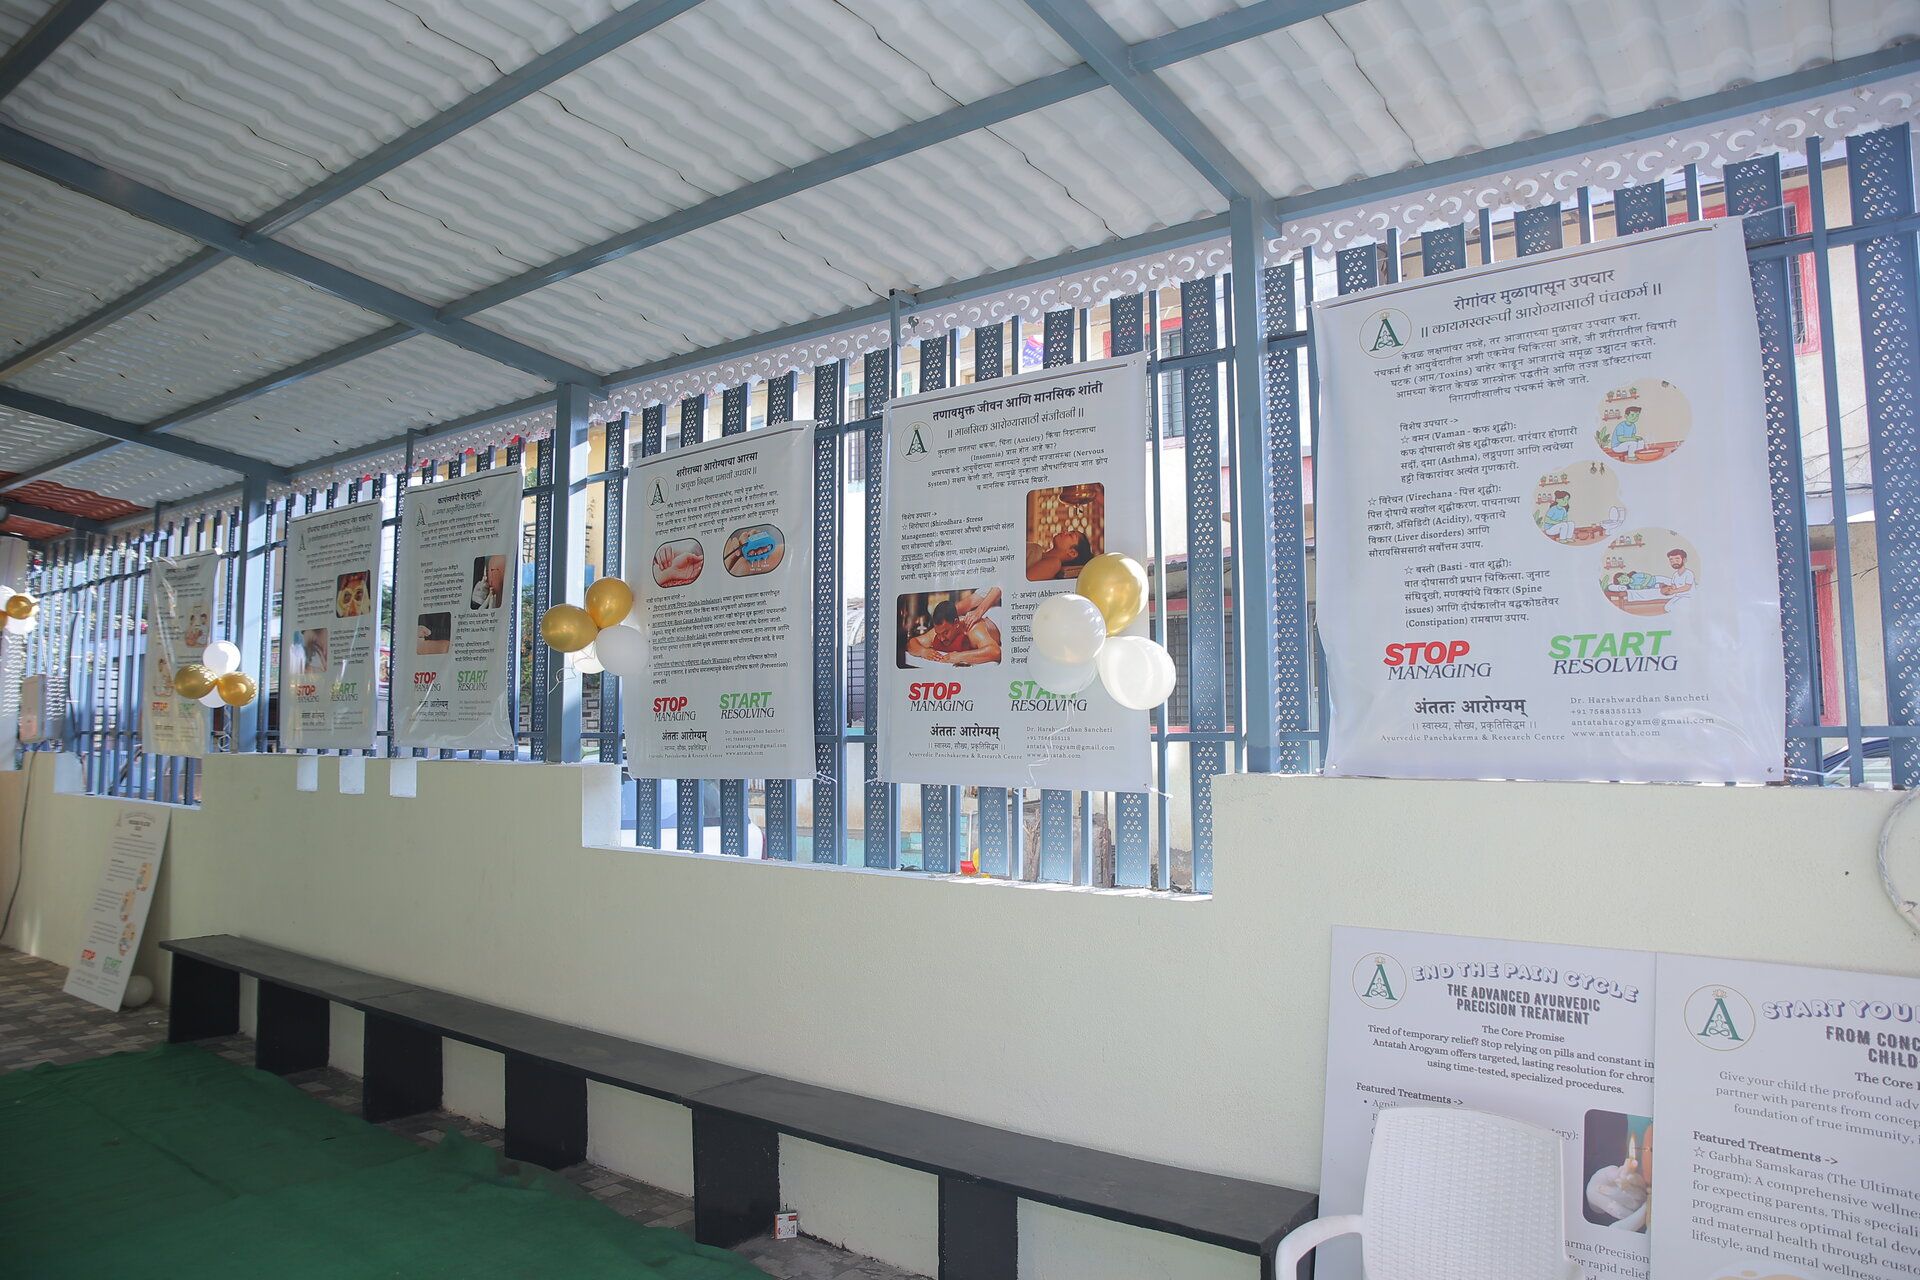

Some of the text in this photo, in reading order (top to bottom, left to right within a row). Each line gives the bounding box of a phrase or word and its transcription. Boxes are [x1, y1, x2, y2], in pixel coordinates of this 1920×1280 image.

[1453, 268, 1615, 311] रोगांवर मुळापासून उपचार
[1598, 280, 1649, 303] पंचकर्म
[932, 379, 1103, 421] तणावमुक्त जीवन आणि मानसिक शांती
[1432, 429, 1465, 441] (Vaman
[1517, 443, 1539, 455] आणि
[1405, 615, 1467, 629] (Constipation)
[1383, 640, 1470, 666] STOP
[1547, 630, 1672, 660] START
[1387, 662, 1493, 680] MANAGING
[1553, 655, 1679, 676] RESOLVING
[414, 671, 437, 684] STOP
[457, 670, 488, 683] START
[719, 691, 772, 710] START
[908, 682, 961, 701] STOP
[1570, 692, 1710, 704] Dr. Harshwardhan Sancheti
[653, 696, 688, 713] STOP
[720, 707, 775, 720] RESOLVING
[910, 700, 974, 712] MANAGING
[1010, 699, 1087, 712] RESOLVING
[1461, 694, 1528, 718] आरोग्यम्
[654, 711, 696, 722] MANAGING
[959, 722, 1001, 741] आरोग्यम्
[1491, 732, 1530, 743] Research
[1534, 732, 1565, 743] Centre
[1410, 961, 1639, 1003] END THE PAIN CYCLE
[1446, 983, 1601, 1012] THE ADVANCED AYURVEDIC
[1456, 998, 1590, 1025] PRECISION TREATMENT
[1762, 1000, 1845, 1020] START
[1481, 1024, 1564, 1043] The Core Promise
[1825, 1025, 1870, 1046] FROM
[1367, 1023, 1390, 1035] Tired
[1392, 1026, 1402, 1036] of
[1402, 1029, 1449, 1044] temporary
[1451, 1034, 1478, 1046] relief?
[1480, 1037, 1502, 1051] Stop
[1504, 1040, 1537, 1056] relying
[1539, 1047, 1552, 1056] on
[1554, 1047, 1574, 1059] pills
[1576, 1050, 1595, 1061] and
[1597, 1054, 1641, 1067] constant
[1372, 1037, 1406, 1050] Antatah
[1408, 1042, 1448, 1056] Arogyam
[1450, 1047, 1476, 1060] offers
[1478, 1052, 1519, 1066] targeted,
[1521, 1055, 1553, 1072] lasting
[1556, 1063, 1606, 1077] resolution
[1609, 1067, 1624, 1079] for
[1426, 1059, 1624, 1094] using time-tested, specialized procedures.
[1854, 1071, 1913, 1090] The Core
[1355, 1080, 1395, 1096] Featured
[1397, 1087, 1451, 1105] Treatments
[1718, 1069, 1744, 1083] Give
[1746, 1075, 1773, 1087] your
[1776, 1078, 1806, 1092] child
[1808, 1083, 1829, 1096] the
[1832, 1089, 1891, 1106] profound
[1715, 1086, 1757, 1103] partner
[1761, 1093, 1787, 1105] with
[1790, 1098, 1836, 1113] parents
[1840, 1103, 1871, 1119] from
[1733, 1102, 1913, 1145] foundation of true immunity,
[1692, 1129, 1744, 1149] Featured
[1748, 1139, 1820, 1163] Treatments
[1708, 1149, 1751, 1167] Garbha
[1755, 1158, 1822, 1181] Samskaras
[1826, 1171, 1855, 1187] (The
[1692, 1162, 1750, 1185] Program):
[1754, 1175, 1763, 1186] A
[1766, 1179, 1867, 1208] comprehensive
[1692, 1178, 1709, 1192] for
[1712, 1185, 1771, 1207] expecting
[1774, 1198, 1827, 1217] parents.
[1831, 1207, 1860, 1224] This
[1692, 1198, 1743, 1217] program
[1747, 1209, 1797, 1228] ensures
[1800, 1221, 1851, 1240] optimal
[1855, 1230, 1887, 1249] fetal
[1594, 1243, 1650, 1264] (Precision
[1588, 1259, 1617, 1273] rapid
